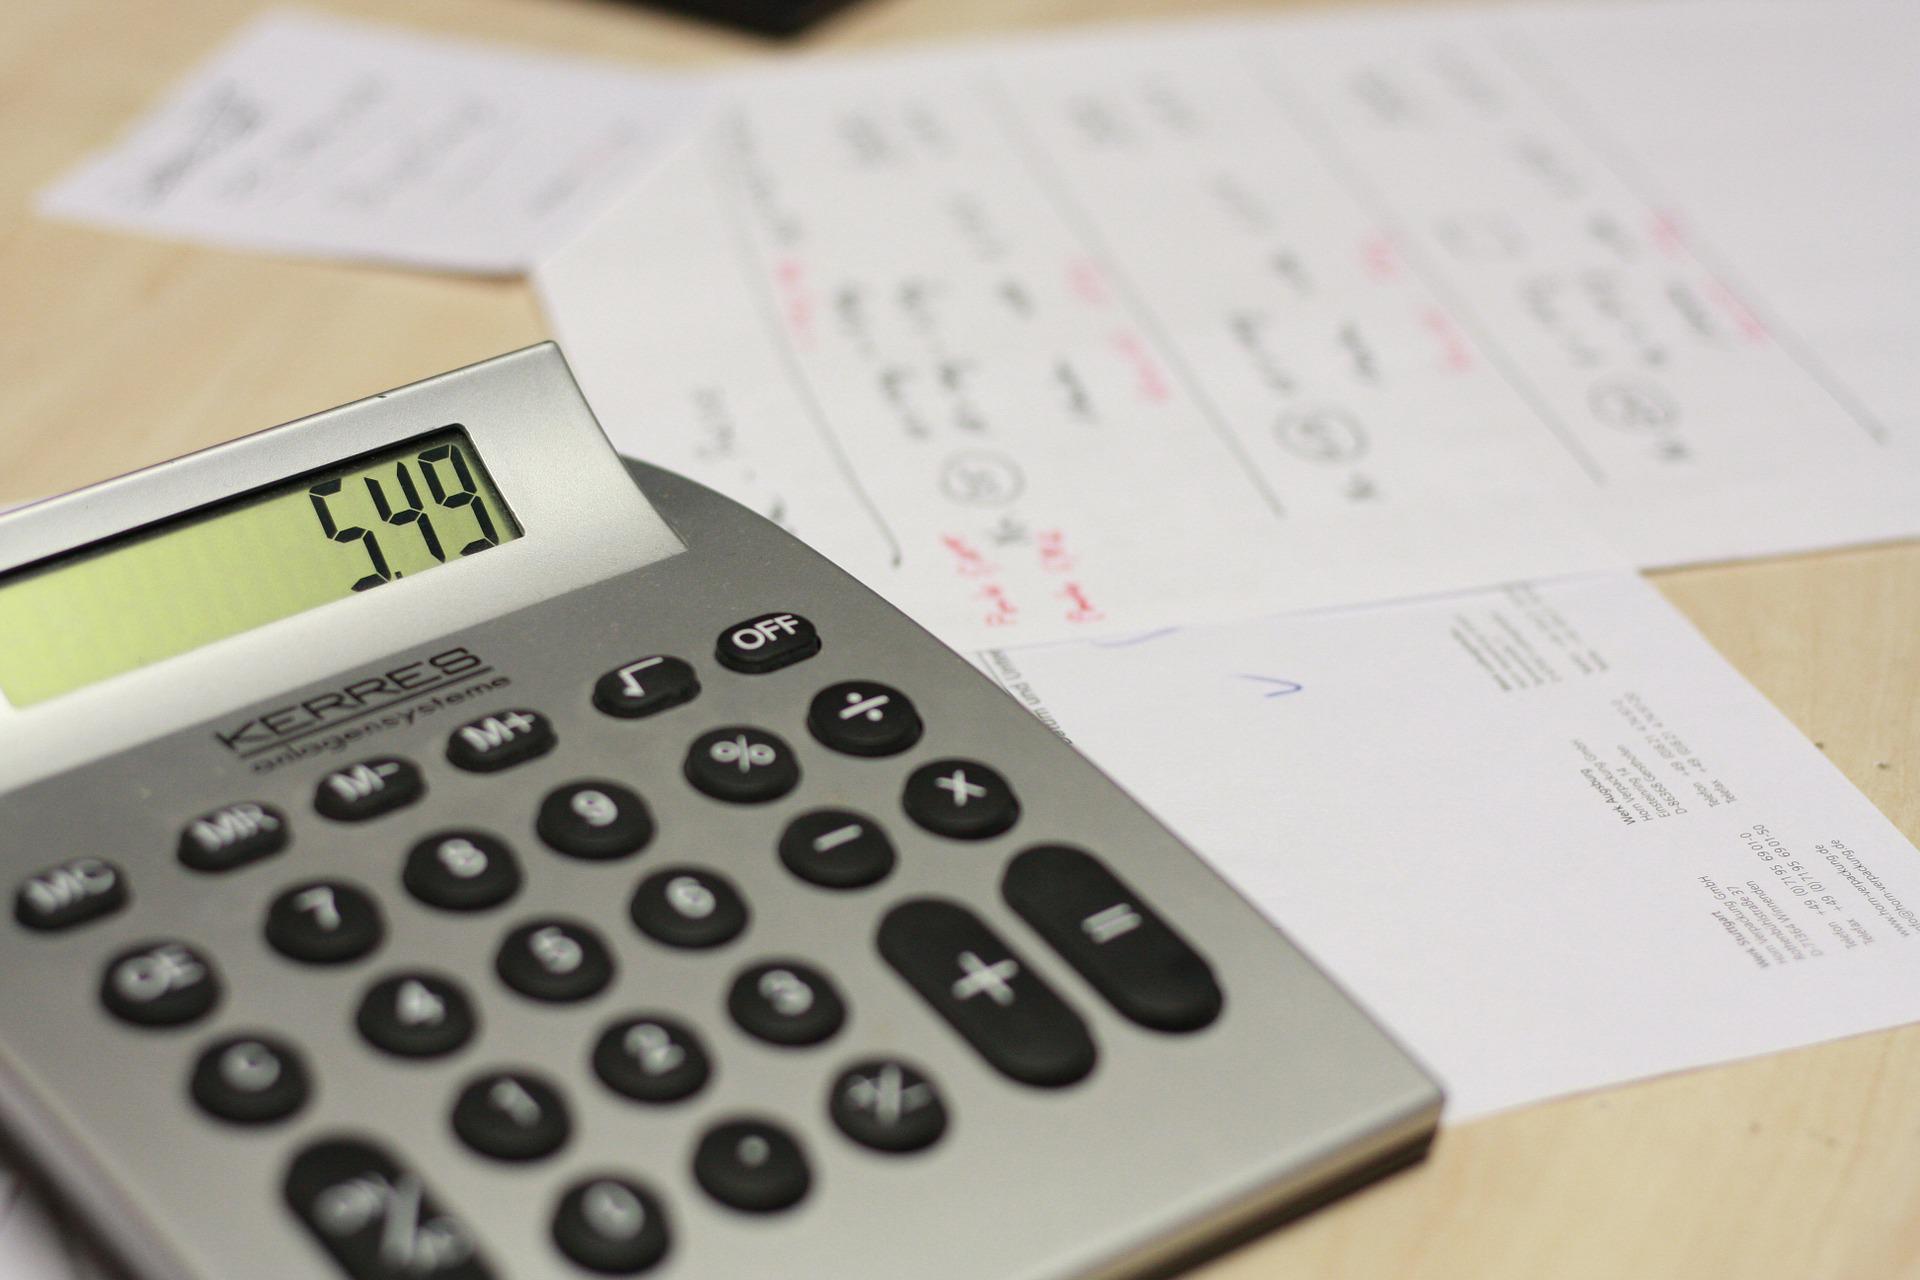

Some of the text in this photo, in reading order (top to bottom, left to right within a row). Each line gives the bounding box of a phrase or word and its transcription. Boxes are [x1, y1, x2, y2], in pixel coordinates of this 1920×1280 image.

[309, 444, 500, 592] 5.49
[731, 614, 800, 652] OFF
[214, 646, 482, 750] KERRES
[1008, 682, 1041, 706] und
[253, 675, 512, 775] anlagensysteme
[461, 710, 536, 753] M+
[328, 761, 402, 803] M-
[1580, 768, 1636, 825] Werk Augsburg
[1693, 782, 1720, 807] Telefon
[1712, 779, 1737, 803] Telefax
[190, 801, 280, 853] MR
[570, 788, 620, 828] 9
[436, 837, 489, 878] 8
[22, 857, 116, 911] MC
[665, 875, 717, 919] 6
[1697, 875, 1726, 901] GmbH
[1727, 885, 1744, 896] 37
[1746, 880, 1790, 923] Winnenden
[1815, 844, 1910, 937] www.horn-verpackung.de
[1821, 895, 1843, 912] +49
[298, 885, 342, 930] 7
[1723, 901, 1767, 944] Verpackung
[1803, 900, 1825, 916] +49
[529, 926, 584, 974] 5
[1712, 911, 1770, 969] Werk Stuttgart
[1828, 921, 1858, 949] Telefon
[1848, 918, 1874, 944] Telefax
[114, 945, 206, 1000] CE
[757, 968, 815, 1016] 3
[395, 979, 447, 1026] 4
[623, 1022, 686, 1077] 2
[491, 1078, 542, 1128] 1
